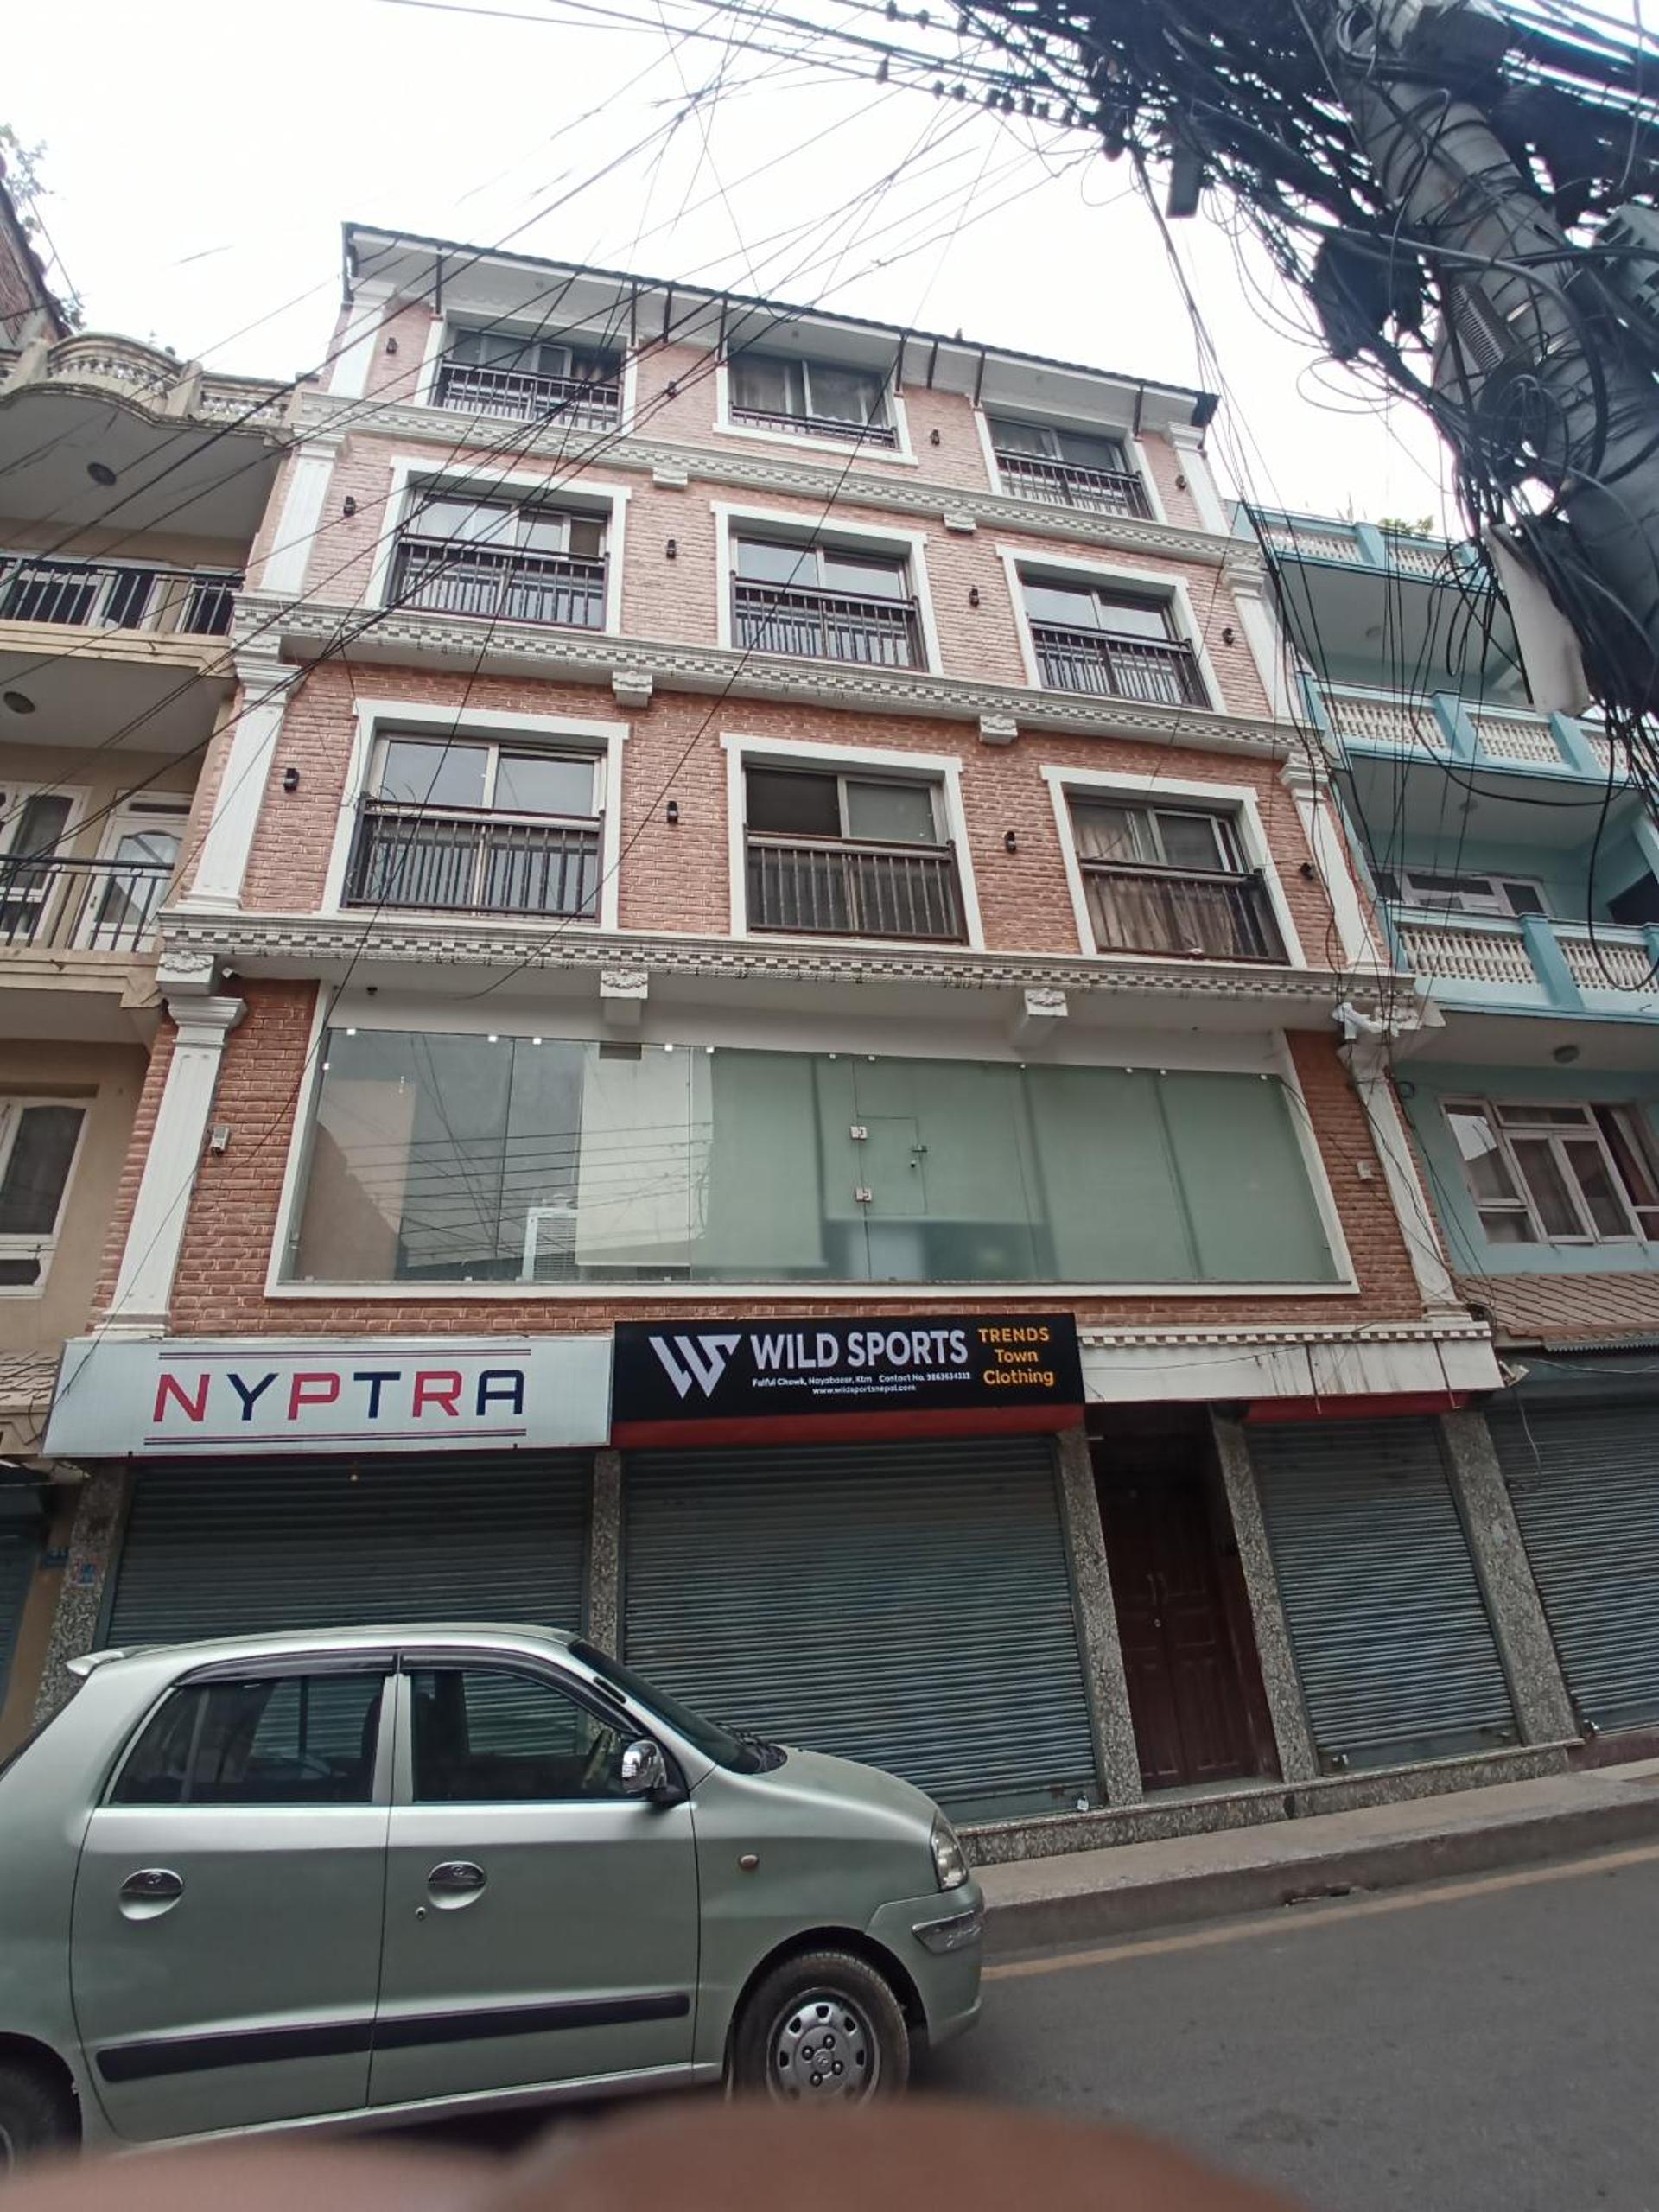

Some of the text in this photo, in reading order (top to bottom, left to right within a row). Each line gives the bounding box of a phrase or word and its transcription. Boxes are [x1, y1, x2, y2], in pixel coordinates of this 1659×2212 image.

[977, 1327, 1050, 1343] TRENDS
[750, 1330, 968, 1370] WILD SPORTS
[994, 1348, 1039, 1363] Town
[878, 1373, 911, 1382] Contact
[983, 1369, 1054, 1387] Clothing
[153, 1370, 524, 1422] NYPTRA
